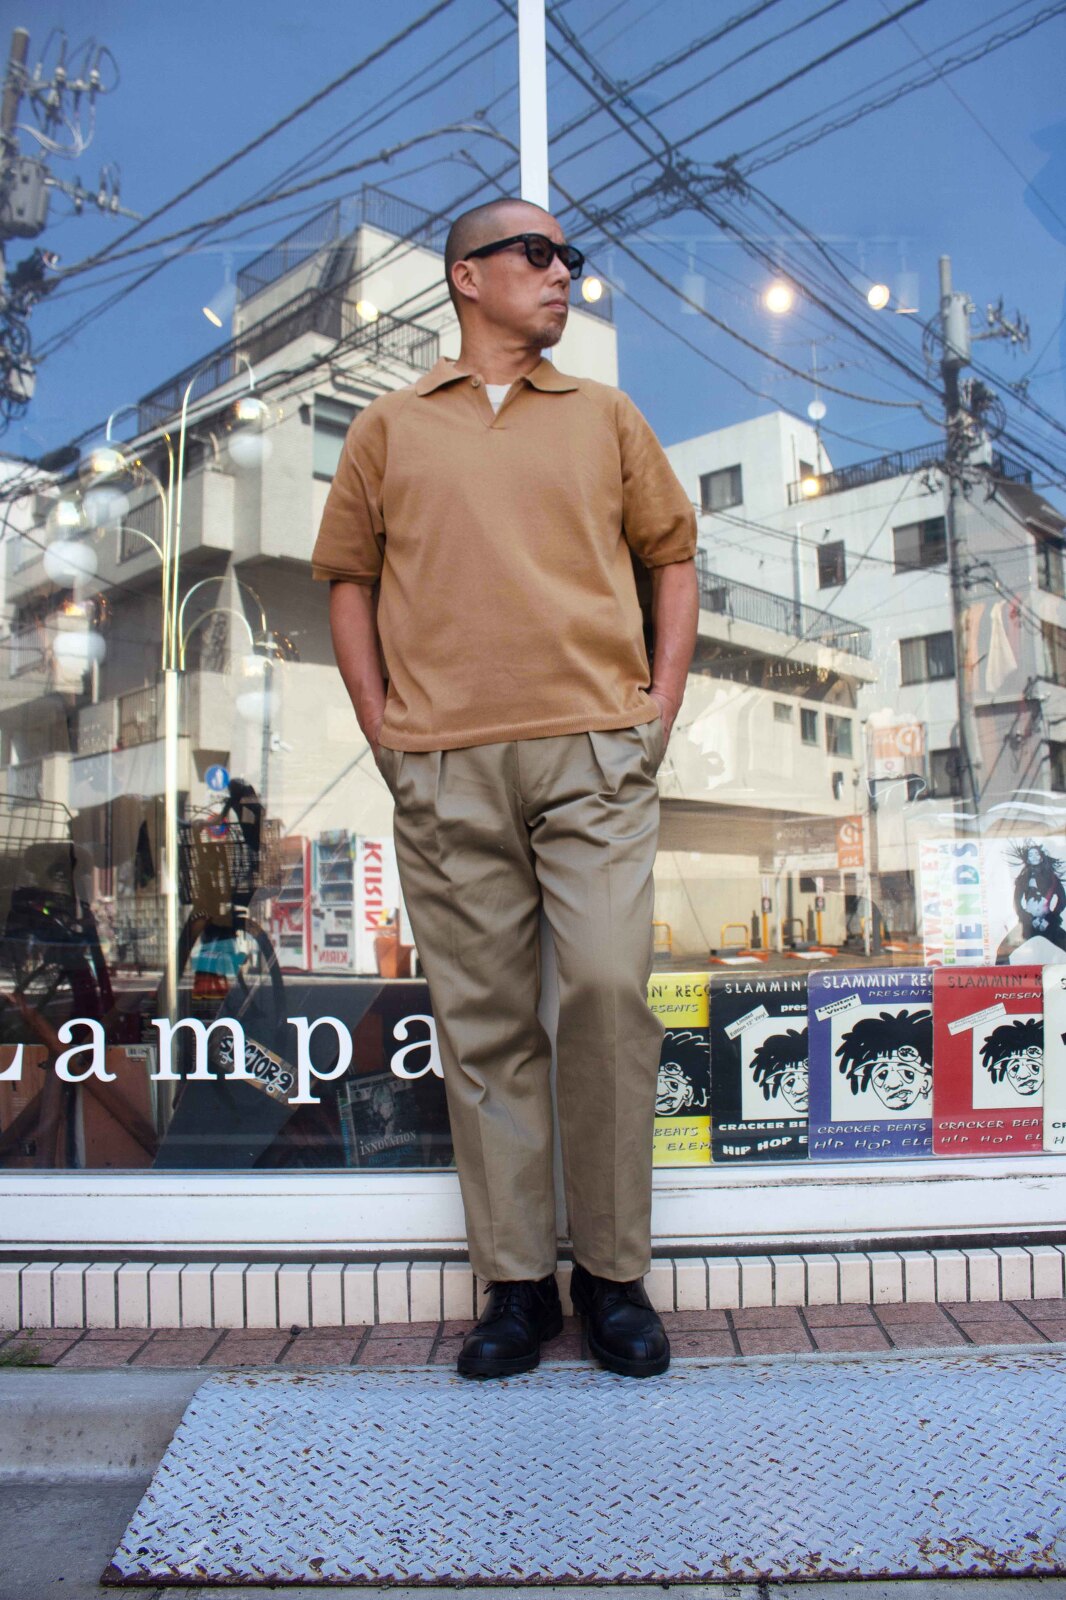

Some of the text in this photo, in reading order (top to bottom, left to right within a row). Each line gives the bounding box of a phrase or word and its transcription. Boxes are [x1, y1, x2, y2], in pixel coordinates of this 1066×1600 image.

[823, 972, 904, 989] SLAMMIN'
[724, 981, 807, 994] SLAMMIN'
[718, 1121, 784, 1131] CRACKER
[817, 1123, 927, 1134] CRACKER BEATS
[938, 1120, 1004, 1130] CRACKER
[814, 1138, 845, 1149] HIP
[854, 1139, 892, 1150] HOP
[941, 1134, 969, 1144] HIP
[980, 1134, 1014, 1144] HOP
[722, 1144, 752, 1156] HIP
[757, 1136, 793, 1151] HOP
